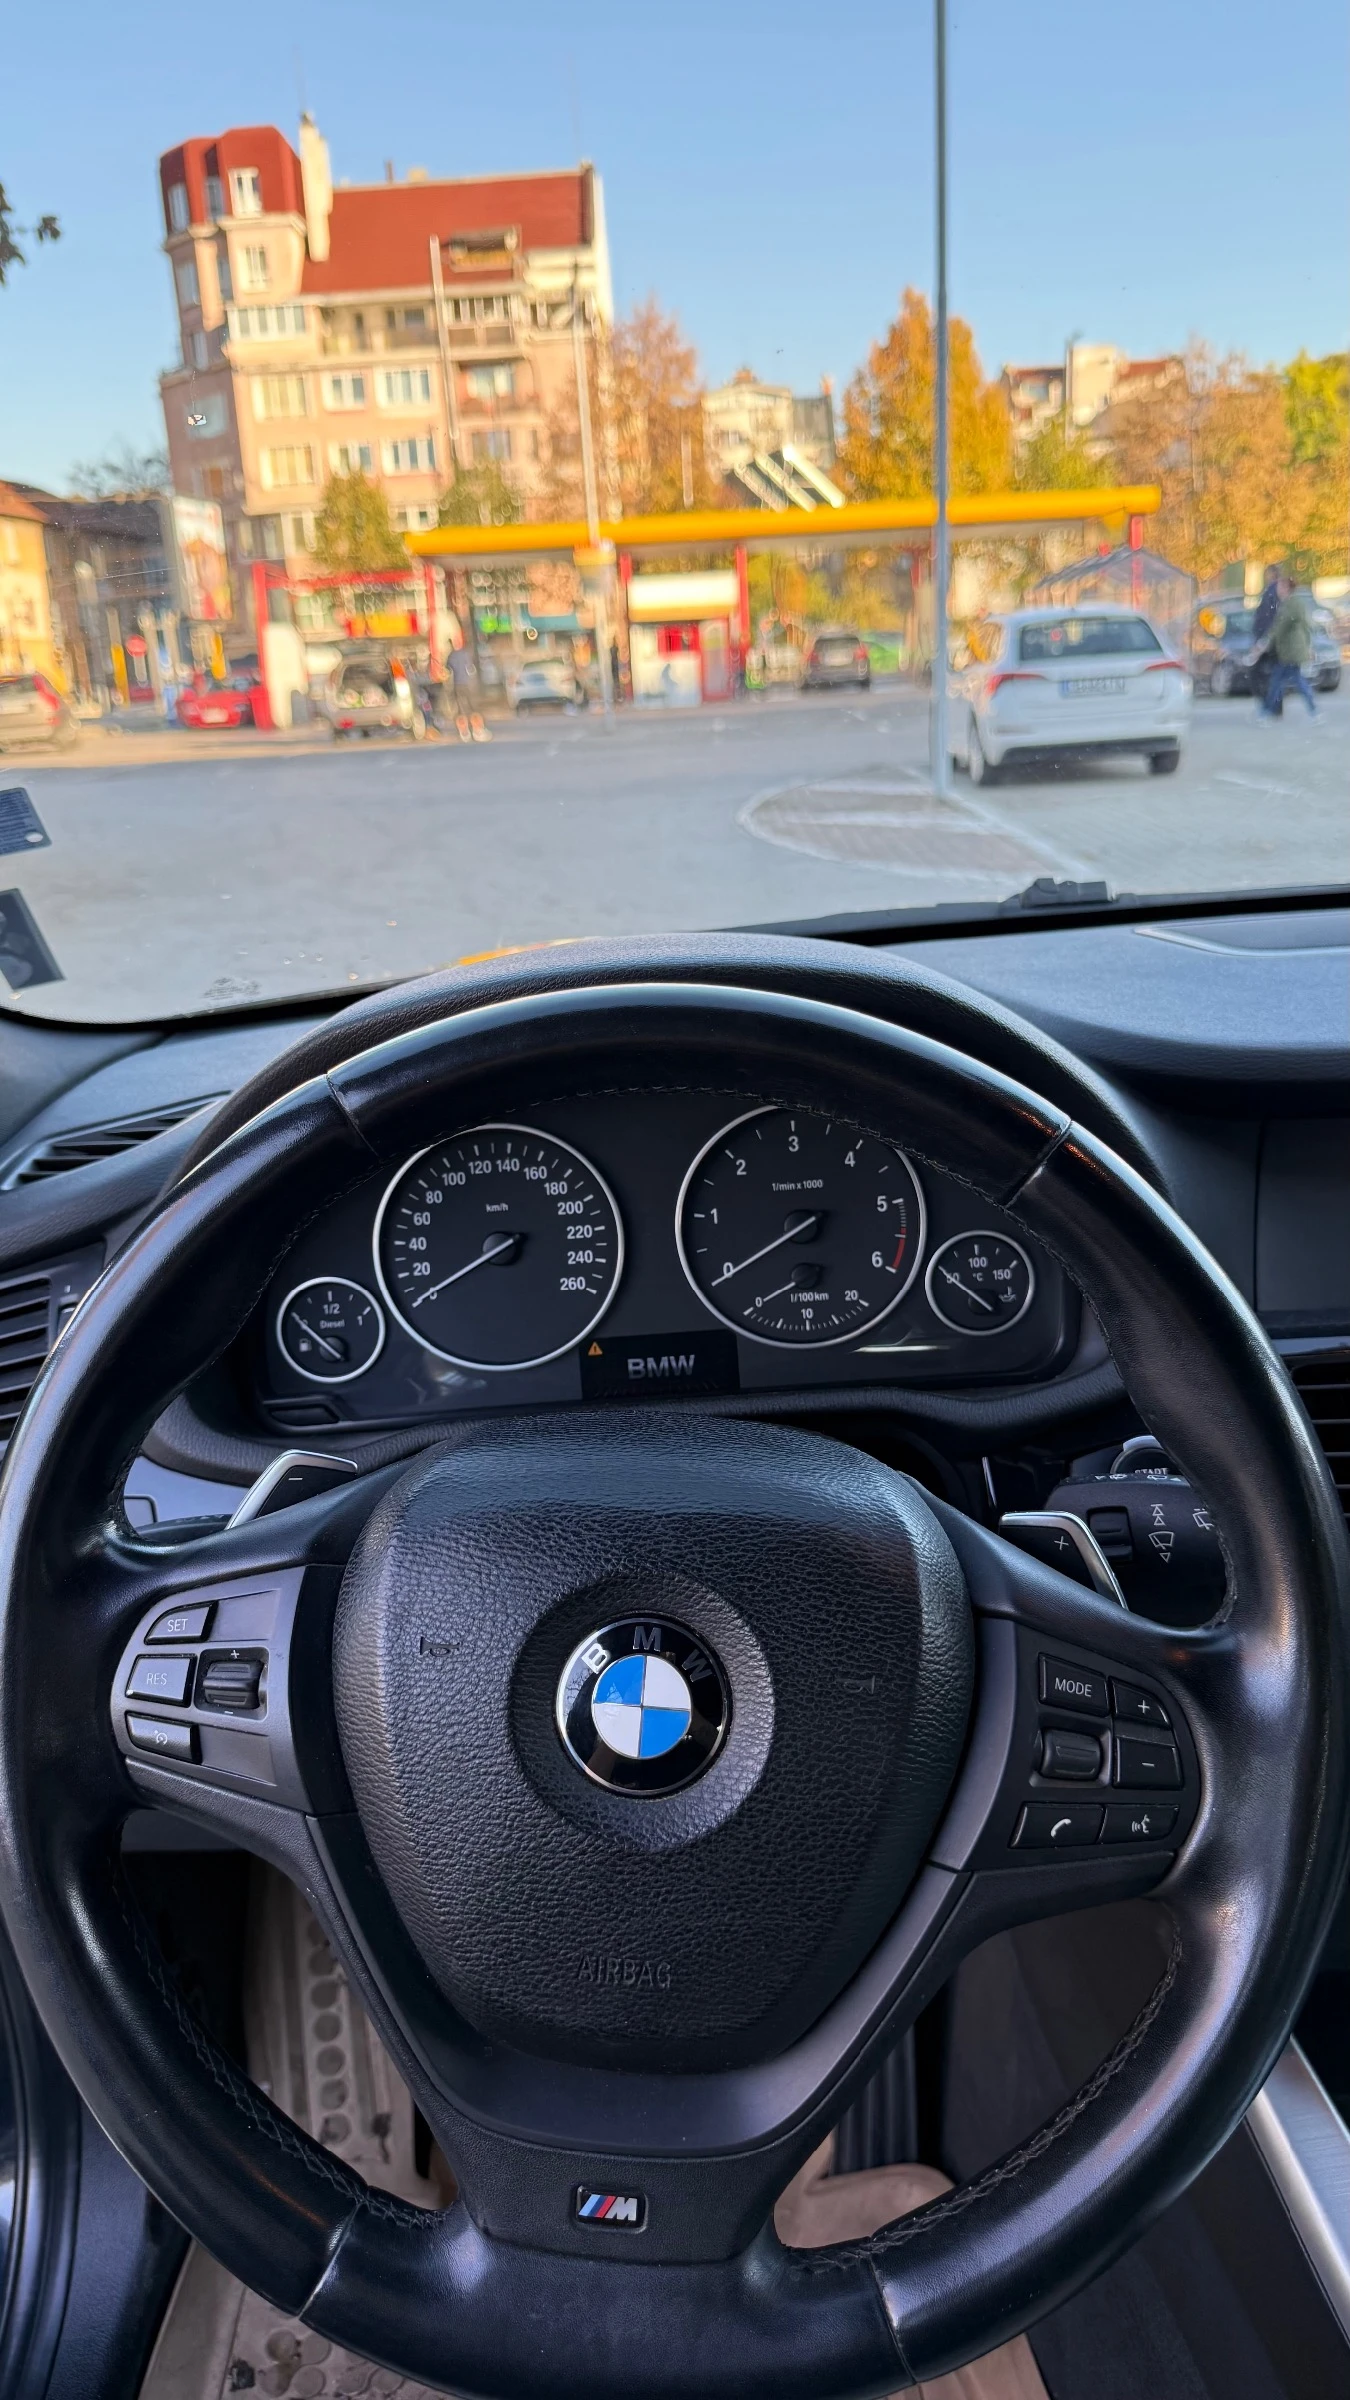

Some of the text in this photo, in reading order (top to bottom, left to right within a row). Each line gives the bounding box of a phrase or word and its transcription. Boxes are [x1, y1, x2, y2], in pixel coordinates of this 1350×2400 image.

[788, 1136, 799, 1152] 3
[496, 1158, 520, 1172] 140
[844, 1151, 856, 1168] 4
[468, 1160, 492, 1175] 120
[523, 1165, 548, 1181] 160
[735, 1159, 747, 1176] 2
[442, 1171, 466, 1186] 100
[803, 1179, 823, 1190] 1000
[544, 1181, 568, 1195] 180
[425, 1190, 443, 1204] 80
[876, 1195, 888, 1212] 5
[486, 1202, 509, 1213] km/h
[557, 1200, 584, 1215] 200
[413, 1212, 431, 1226] 60
[710, 1208, 718, 1224] 1
[566, 1225, 593, 1240] 220
[408, 1236, 427, 1251] 40
[567, 1250, 593, 1265] 240
[871, 1251, 883, 1268] 6
[968, 1256, 988, 1268] 100
[412, 1262, 431, 1276] 20
[723, 1262, 734, 1279] 0
[992, 1268, 1012, 1280] 150
[560, 1276, 586, 1291] 260
[755, 1296, 763, 1308] 0
[844, 1290, 858, 1301] 20
[323, 1303, 340, 1315] 1/2
[800, 1308, 814, 1319] 10
[320, 1319, 345, 1330] Diesel
[357, 1315, 363, 1326] 1
[627, 1354, 696, 1380] BMW
[167, 1618, 189, 1633] SET
[581, 1625, 713, 1683] BMW
[146, 1672, 168, 1686] RES
[1054, 1677, 1093, 1698] MODE
[577, 1954, 672, 1989] AIRBAG
[604, 2196, 638, 2222] M
